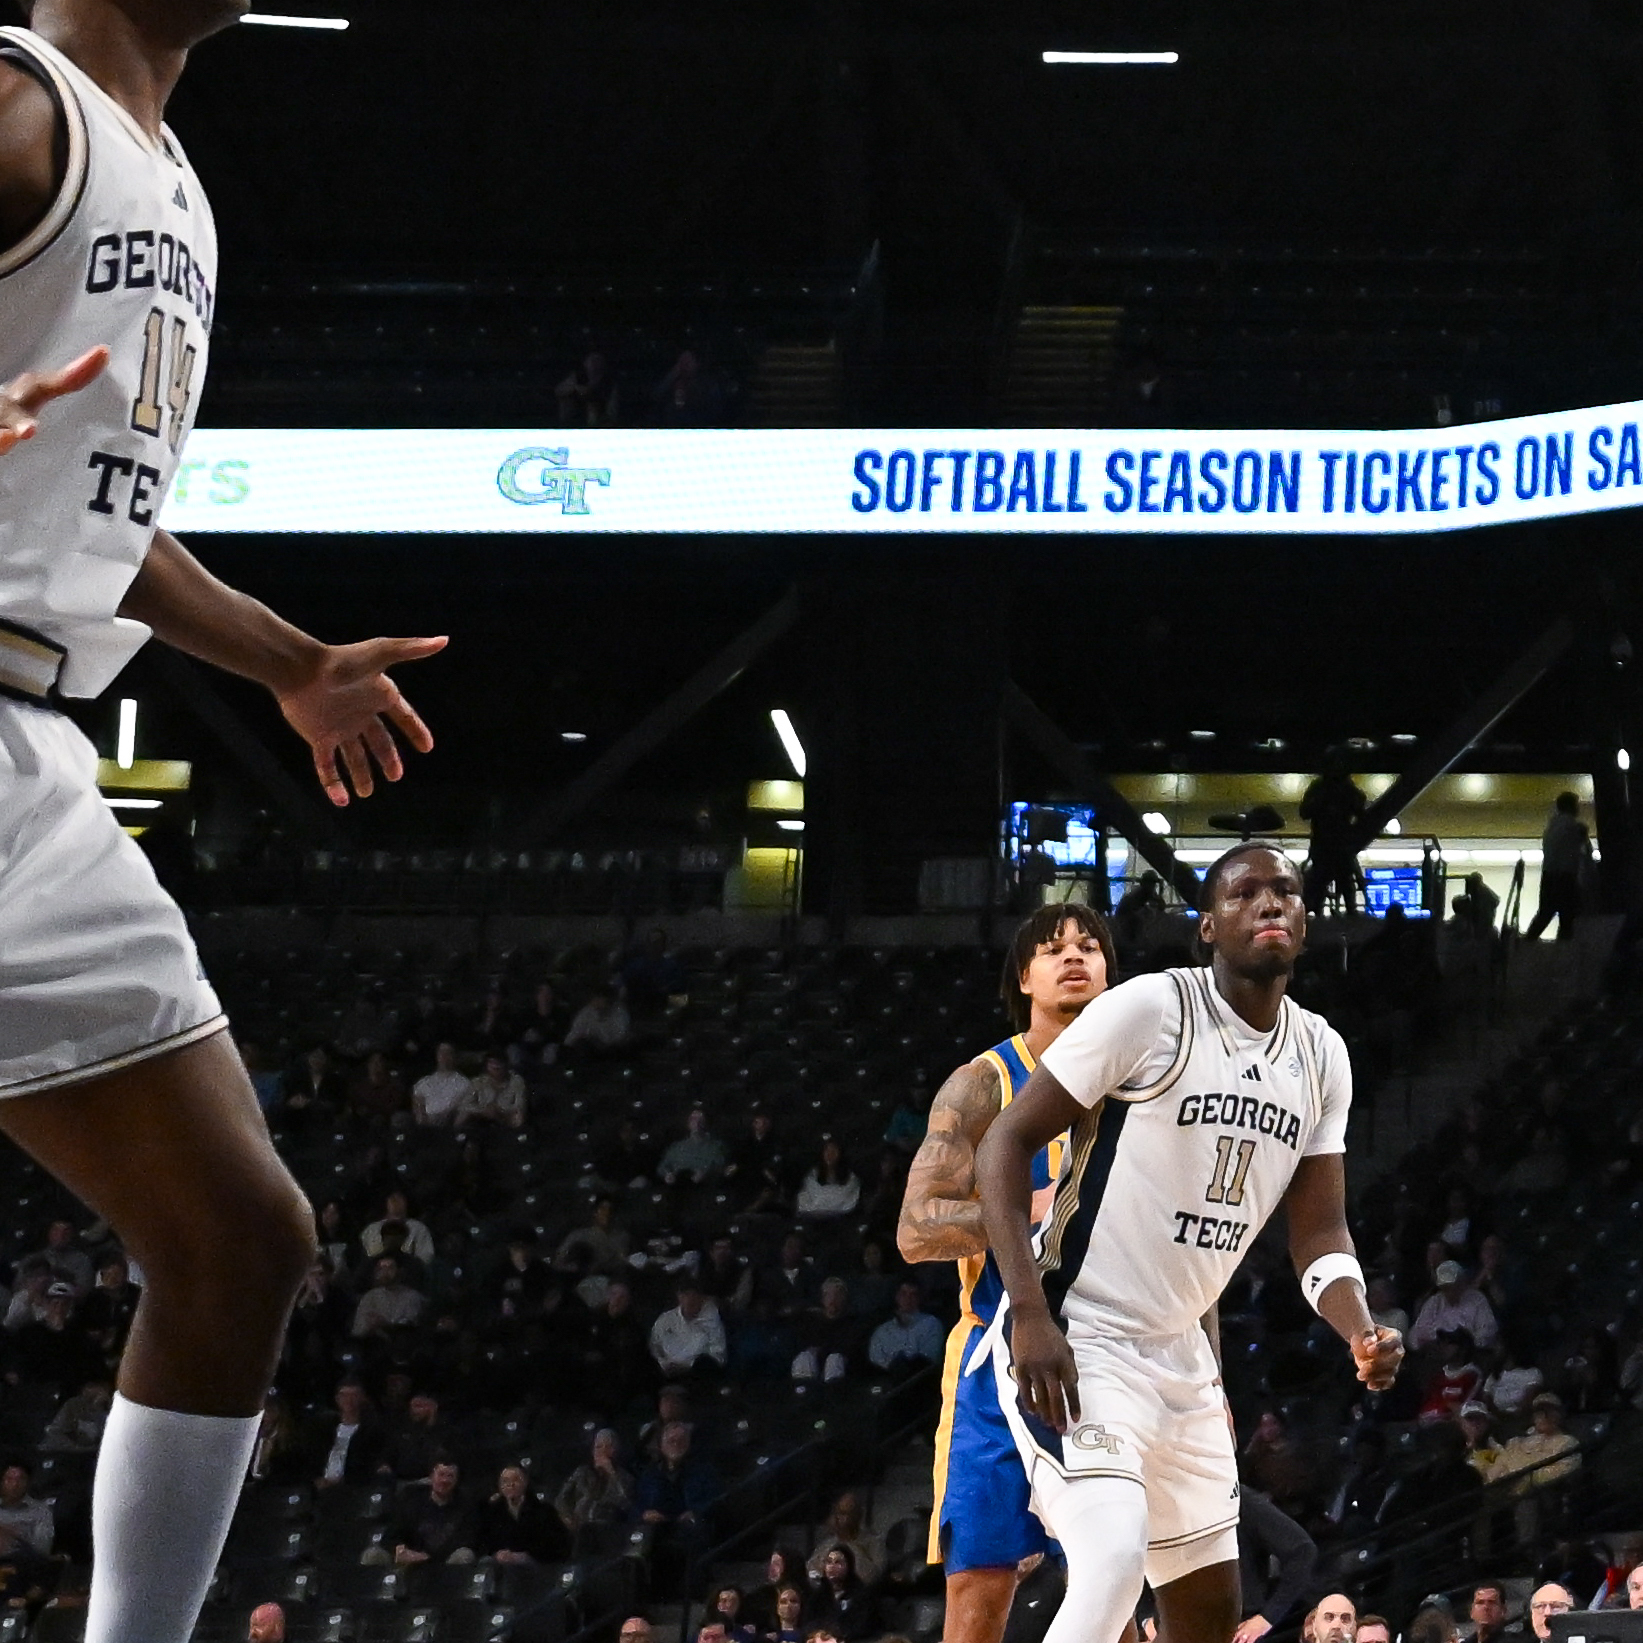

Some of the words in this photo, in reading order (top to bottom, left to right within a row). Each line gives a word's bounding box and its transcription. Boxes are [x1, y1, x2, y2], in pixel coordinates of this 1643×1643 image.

[86, 449, 162, 527] TE
[851, 447, 1088, 515] SOFTBALL
[1103, 447, 1302, 515] SEASON
[1320, 446, 1500, 515] TICKETS
[1514, 433, 1574, 502] ON
[1176, 1092, 1301, 1151] GEORGIA
[1205, 1134, 1257, 1207] 11
[1173, 1210, 1249, 1253] TECH
